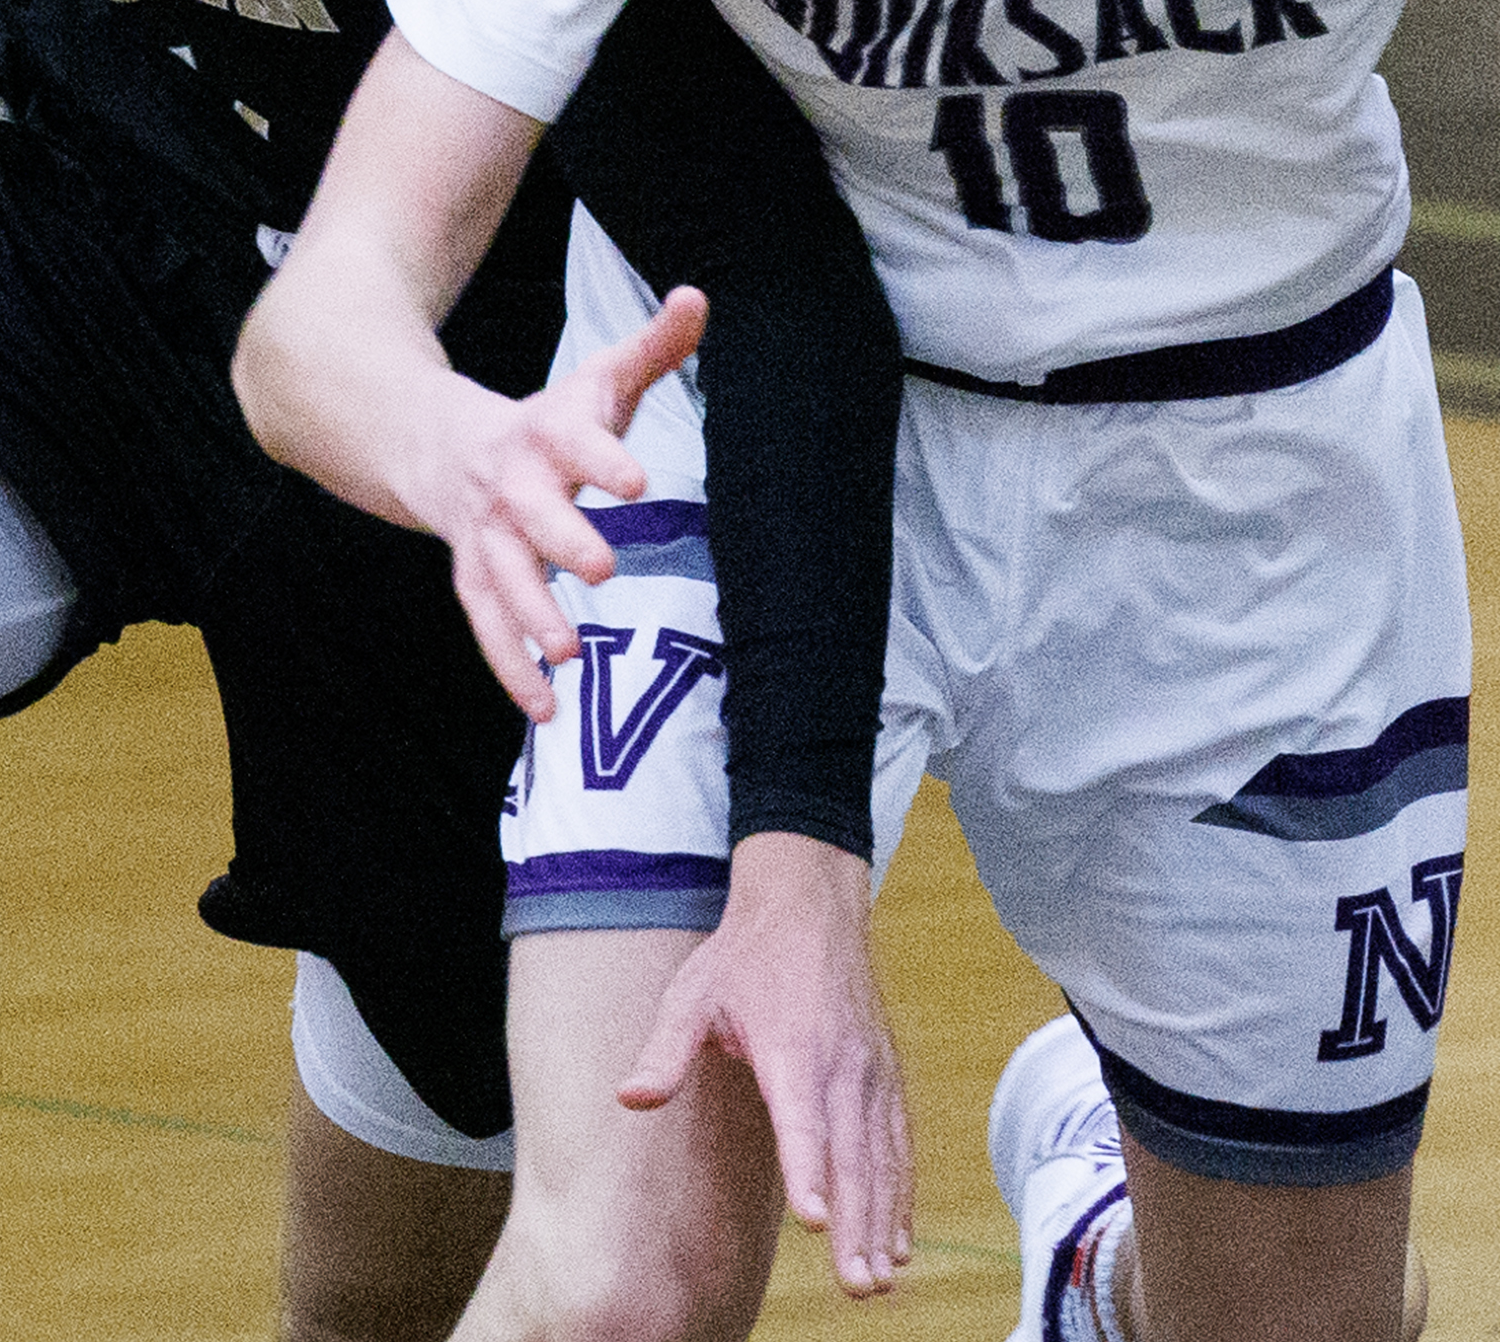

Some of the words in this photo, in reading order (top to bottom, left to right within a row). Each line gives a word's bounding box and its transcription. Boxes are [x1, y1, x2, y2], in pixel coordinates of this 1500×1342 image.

[929, 88, 1154, 245] 10
[577, 622, 725, 792] V
[1316, 850, 1465, 1063] N
